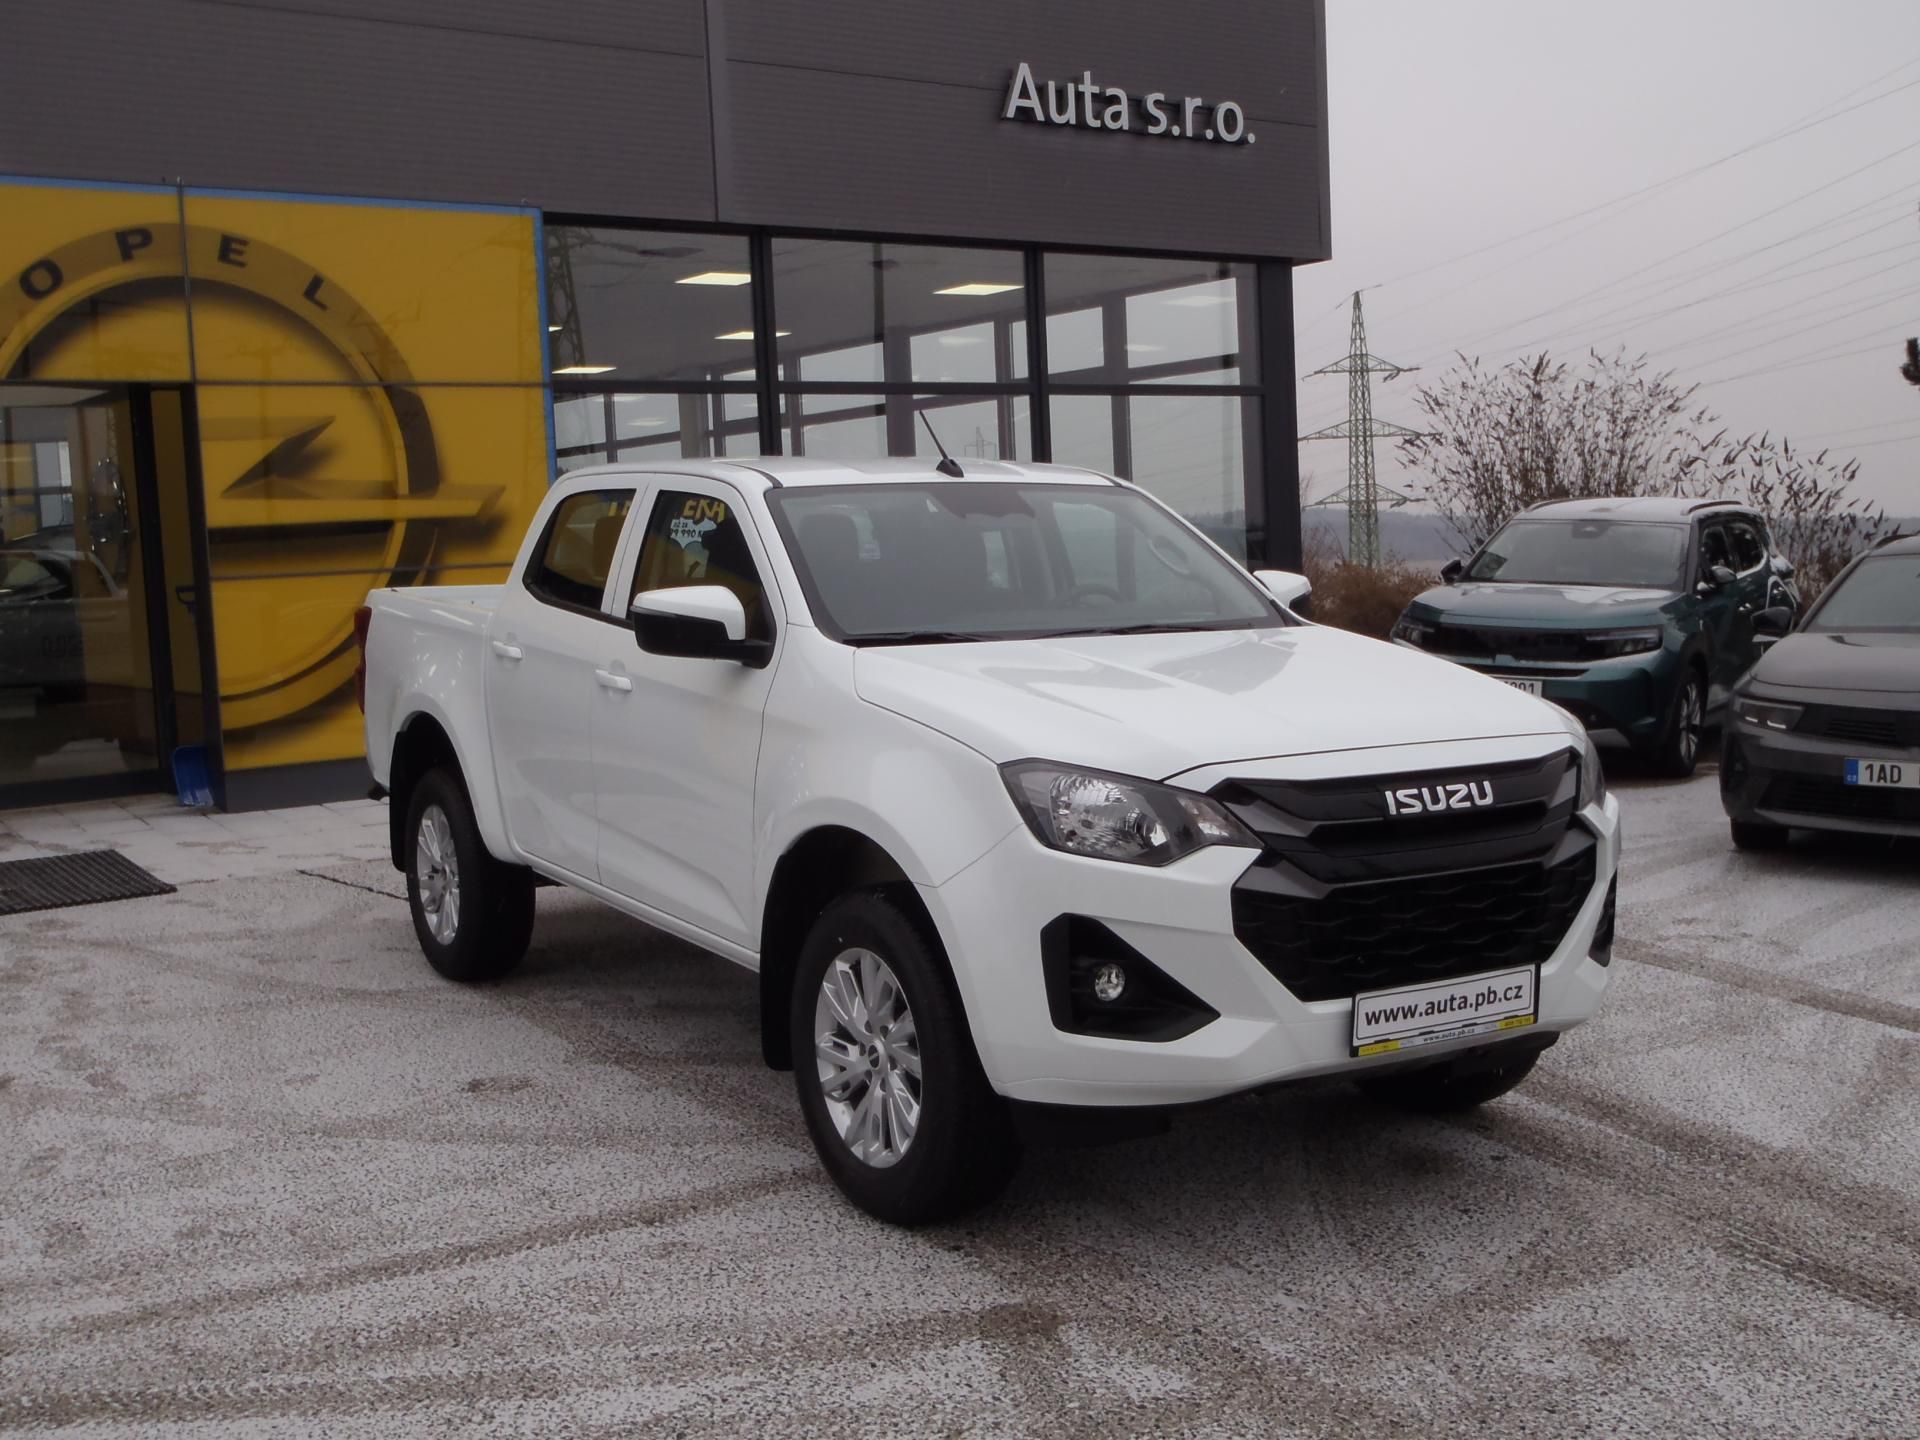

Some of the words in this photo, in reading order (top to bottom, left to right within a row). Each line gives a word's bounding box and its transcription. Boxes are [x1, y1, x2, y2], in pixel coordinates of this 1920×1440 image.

[1004, 62, 1129, 130] Auta
[1145, 92, 1256, 143] s.r.o.
[19, 228, 328, 312] OPEL
[1864, 763, 1902, 784] 1AD
[1384, 780, 1494, 815] ISUZU
[1365, 985, 1523, 1026] www.auta.pb.cz
